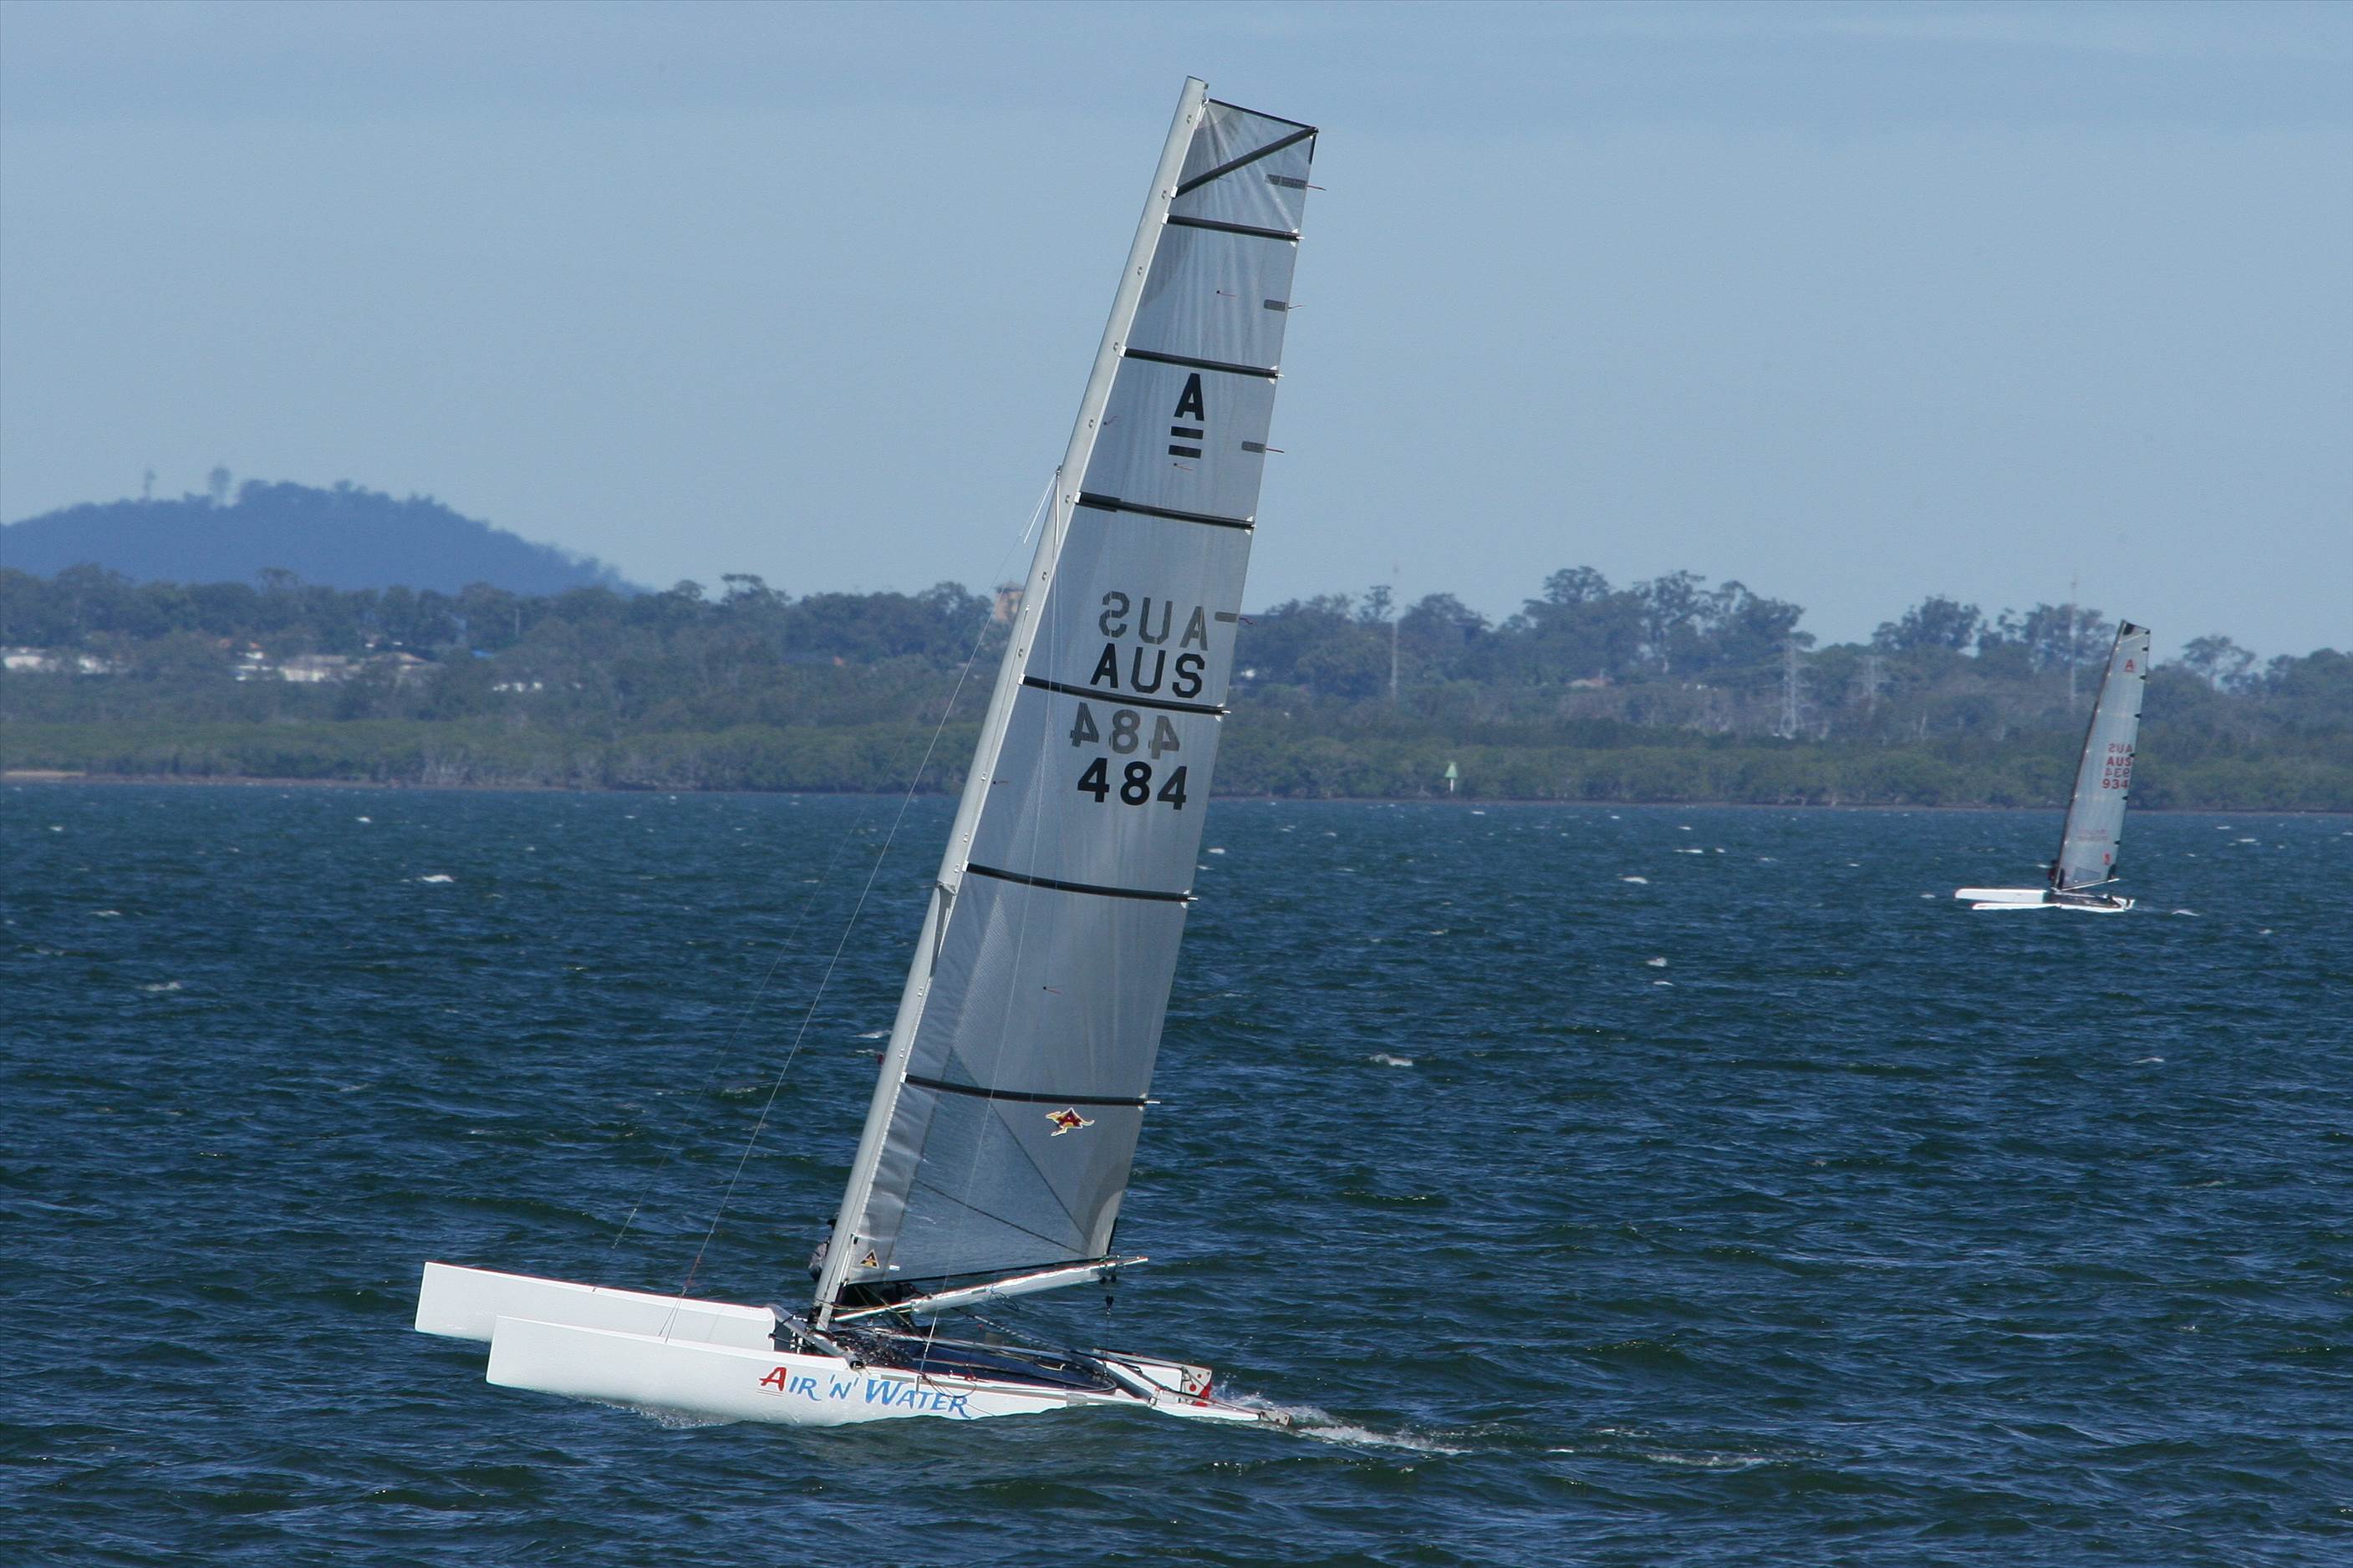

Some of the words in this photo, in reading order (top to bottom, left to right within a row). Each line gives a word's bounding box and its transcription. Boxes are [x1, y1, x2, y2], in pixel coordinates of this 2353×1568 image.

[1174, 373, 1205, 421] A
[1090, 643, 1205, 699] AUS
[1077, 757, 1188, 811] 484
[2102, 778, 2128, 789] 934
[2106, 756, 2132, 766] AUS
[759, 1367, 822, 1401] AIR
[864, 1379, 971, 1419] WATER
